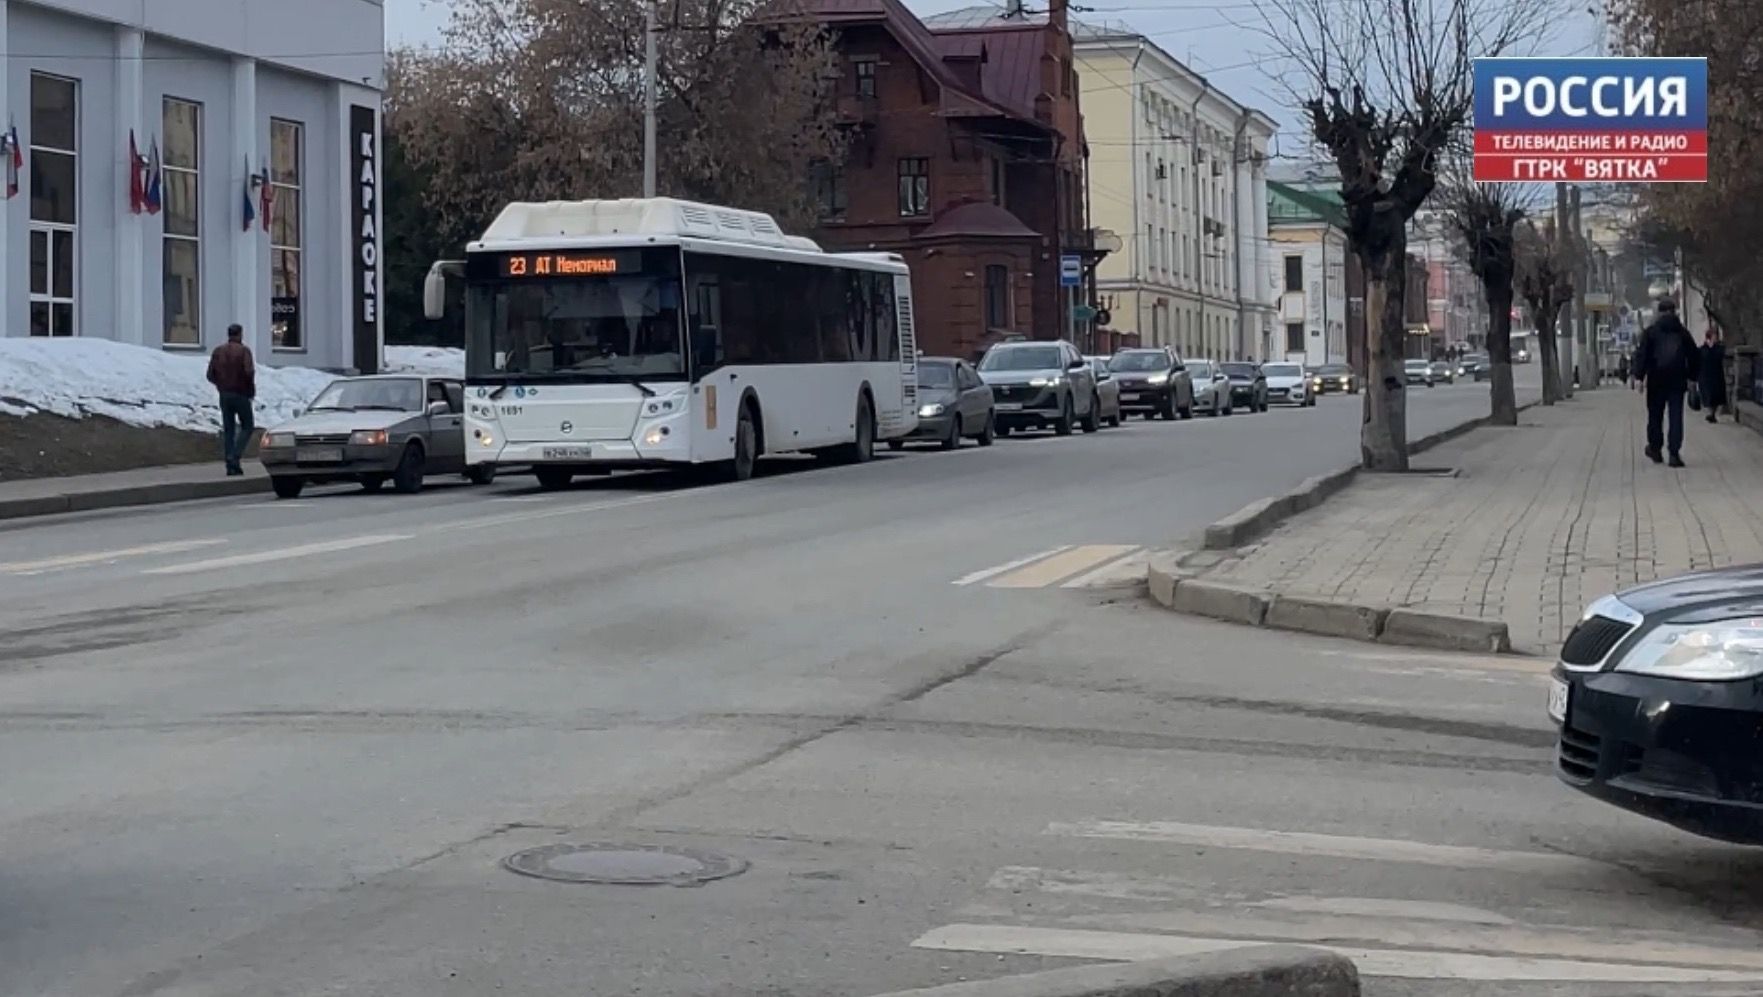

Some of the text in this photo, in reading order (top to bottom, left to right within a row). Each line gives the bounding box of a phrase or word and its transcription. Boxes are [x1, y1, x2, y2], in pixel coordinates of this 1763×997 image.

[361, 132, 376, 322] КАРАОКЕ
[510, 256, 526, 274] 23
[556, 256, 616, 273] Мемориал
